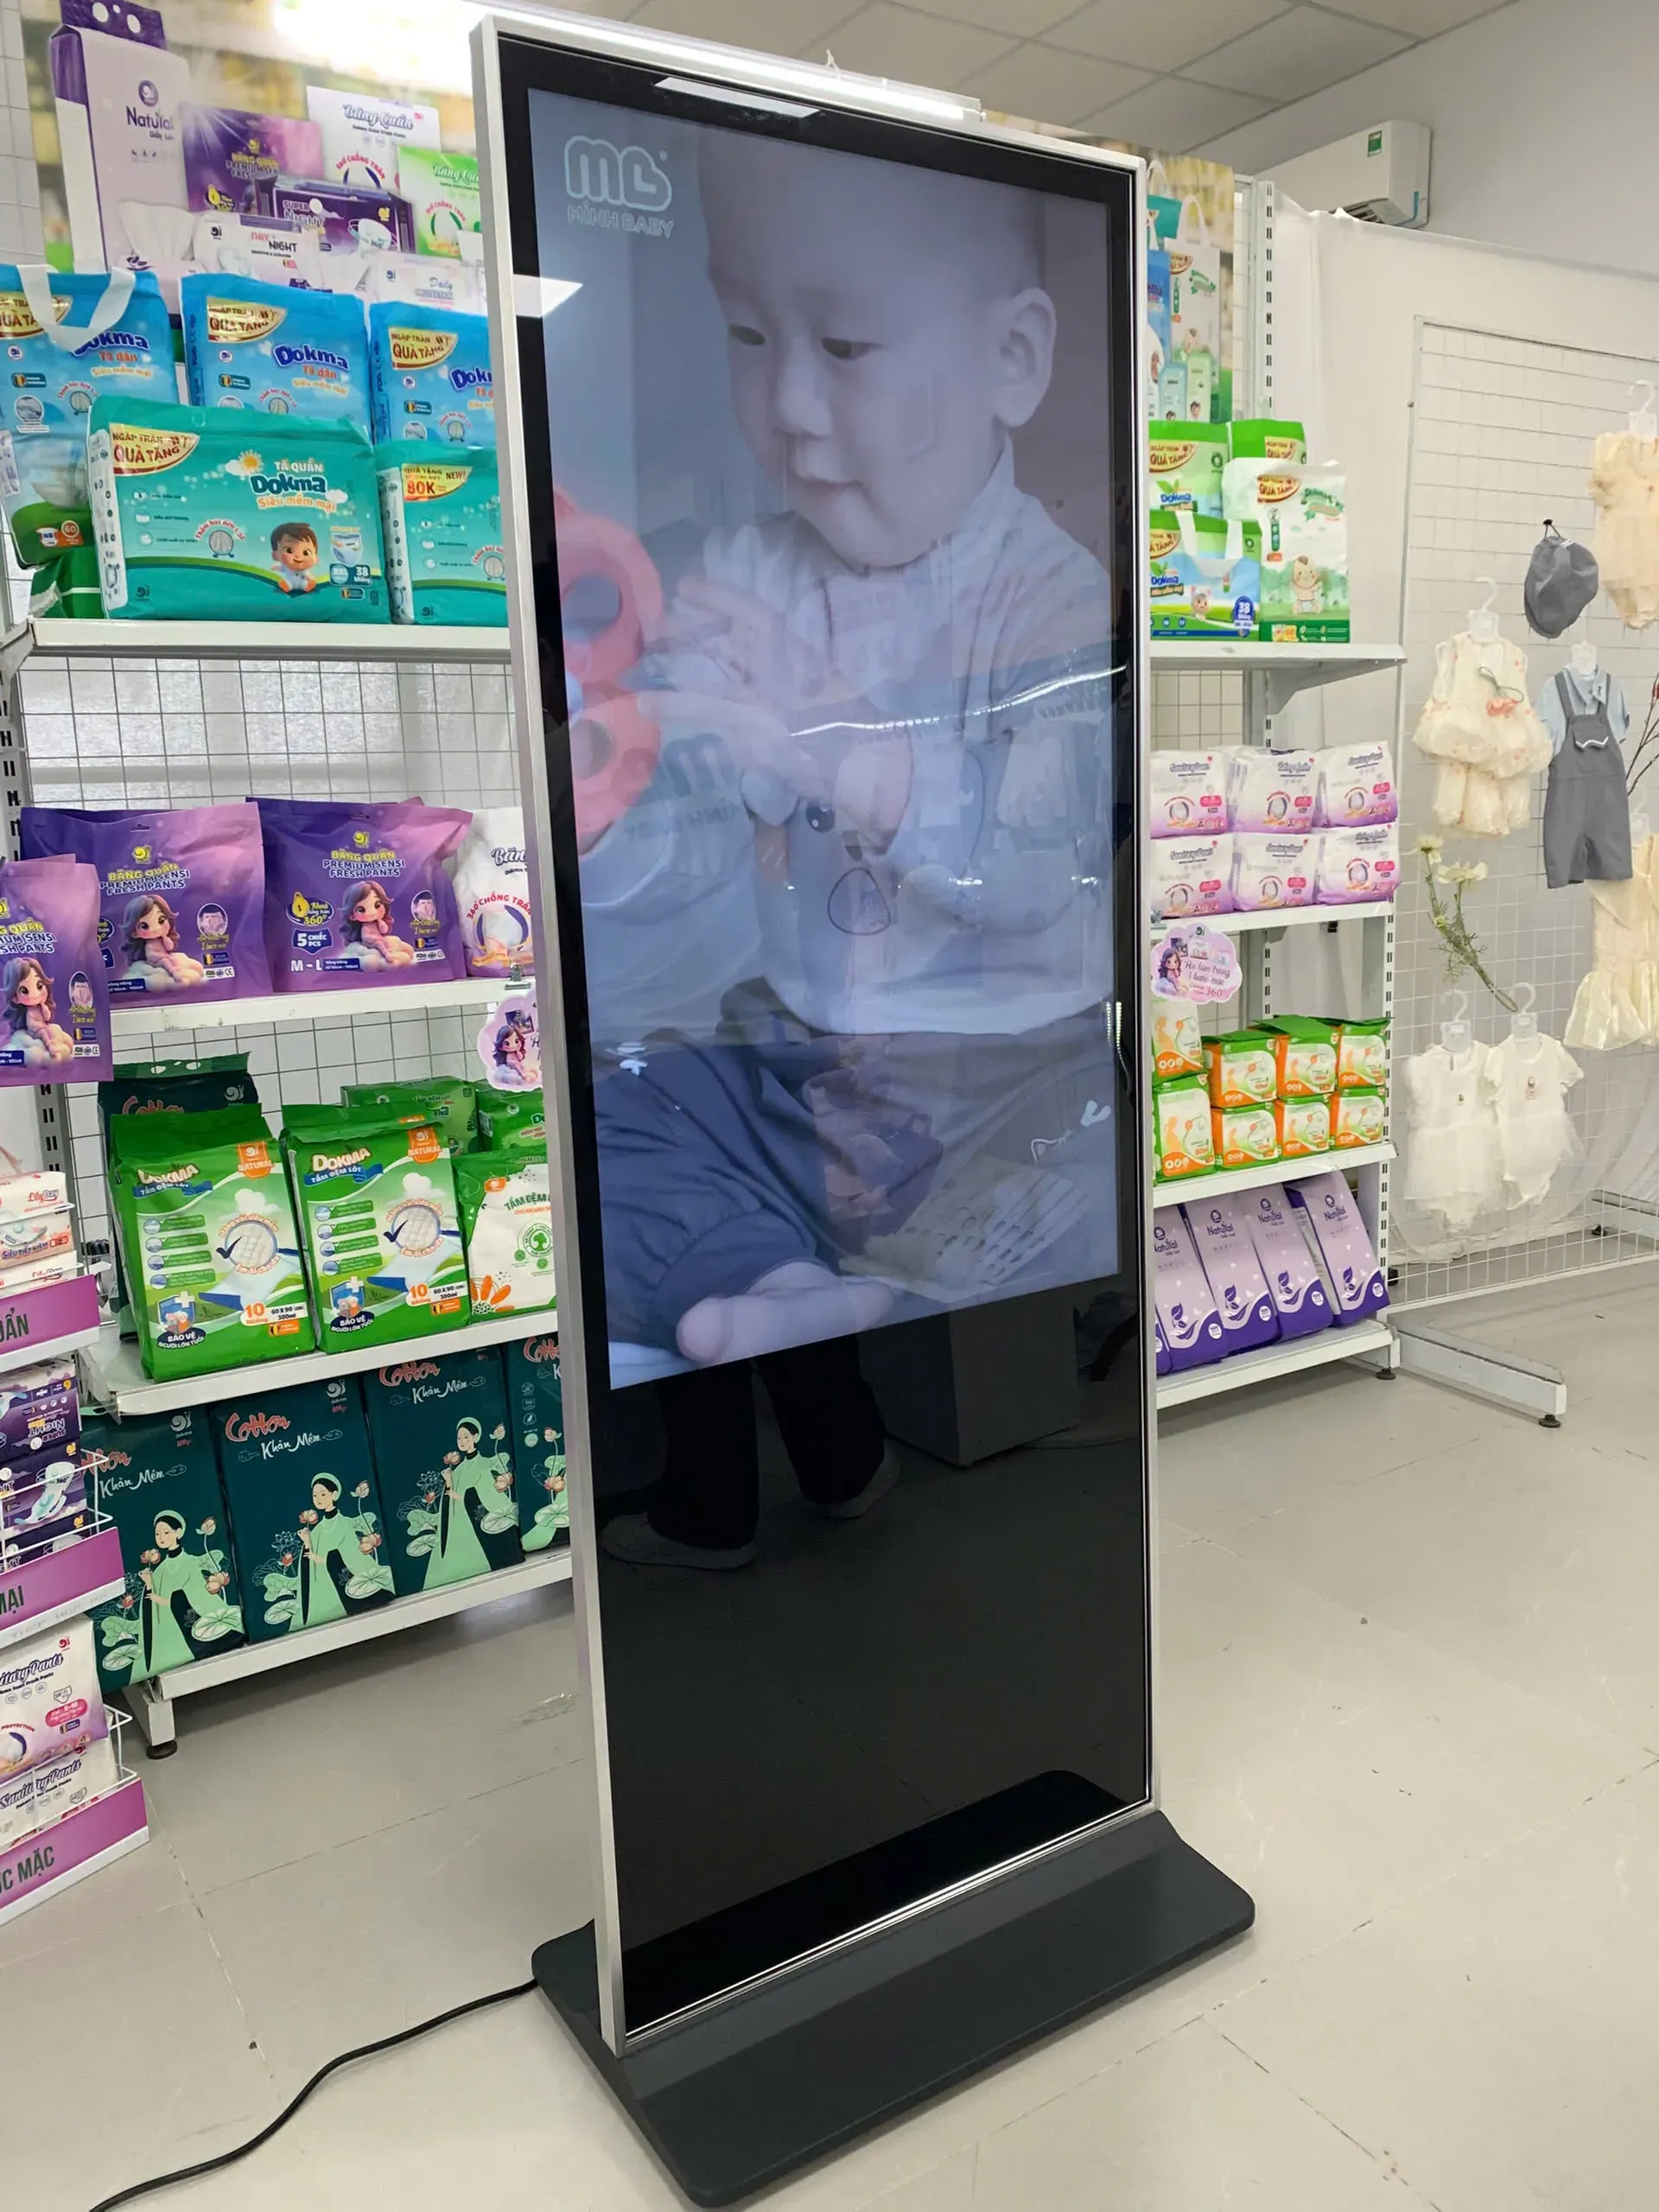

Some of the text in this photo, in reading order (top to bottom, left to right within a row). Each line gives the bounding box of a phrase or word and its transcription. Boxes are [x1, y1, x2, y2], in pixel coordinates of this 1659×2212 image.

[283, 200, 309, 212] SUPER
[283, 209, 325, 228] NIGHT
[621, 213, 675, 238] BABY
[269, 240, 297, 253] NIGHT
[429, 276, 453, 290] Daily
[272, 344, 350, 372] Dokma
[392, 342, 419, 360] QUÀ
[449, 366, 492, 391] Dok
[113, 443, 181, 463] QUÀ TẶNG
[1150, 453, 1168, 466] QUÀ
[249, 473, 327, 494] Dokma
[406, 480, 435, 495] 80K
[1259, 483, 1276, 496] QUÀ
[257, 492, 337, 512] Siêu mềm mại
[1160, 493, 1192, 503] Dokma
[355, 566, 369, 576] 38
[1150, 575, 1179, 586] Dokma
[331, 848, 396, 863] BĂNG QUẦN
[491, 847, 526, 867] Băn
[107, 861, 180, 882] BĂNG QUẦN
[322, 858, 406, 870] PREMIUM SENSI
[99, 869, 190, 891] PREMIUM SENSI
[329, 868, 401, 879] FRESH PANTS
[106, 878, 186, 896] FRESH PANTS
[478, 892, 510, 906] CHỐNG
[303, 914, 328, 926] 360°
[23, 931, 57, 944] SENSI
[296, 932, 308, 947] 5
[17, 942, 54, 954] PANTS
[225, 967, 233, 976] CE
[290, 959, 303, 972] M
[315, 959, 322, 971] L
[92, 1046, 99, 1056] CE
[407, 1145, 442, 1157] NATURAL
[238, 1160, 274, 1173] NATURAL
[311, 1147, 372, 1173] DOKMA
[310, 1165, 362, 1184] TẤM ĐỆM LÓT
[504, 1192, 547, 1211] TẤM ĐỆM
[1257, 1210, 1283, 1223] Natural
[1206, 1221, 1235, 1236] Natural
[409, 1283, 429, 1300] 10
[245, 1301, 265, 1319] 10
[339, 1313, 366, 1327] BẢO VỆ
[167, 1331, 196, 1343] BẢO VỆ
[378, 1360, 441, 1388] Cotton
[28, 1417, 66, 1439] NIGHT
[225, 1411, 291, 1443] Cotton
[29, 1652, 64, 1676] Pants
[25, 1676, 40, 1686] Fresh
[39, 1672, 54, 1681] Pants
[48, 1758, 82, 1784] Pants
[58, 1777, 72, 1789] Pants
[16, 1845, 55, 1884] MẶC
